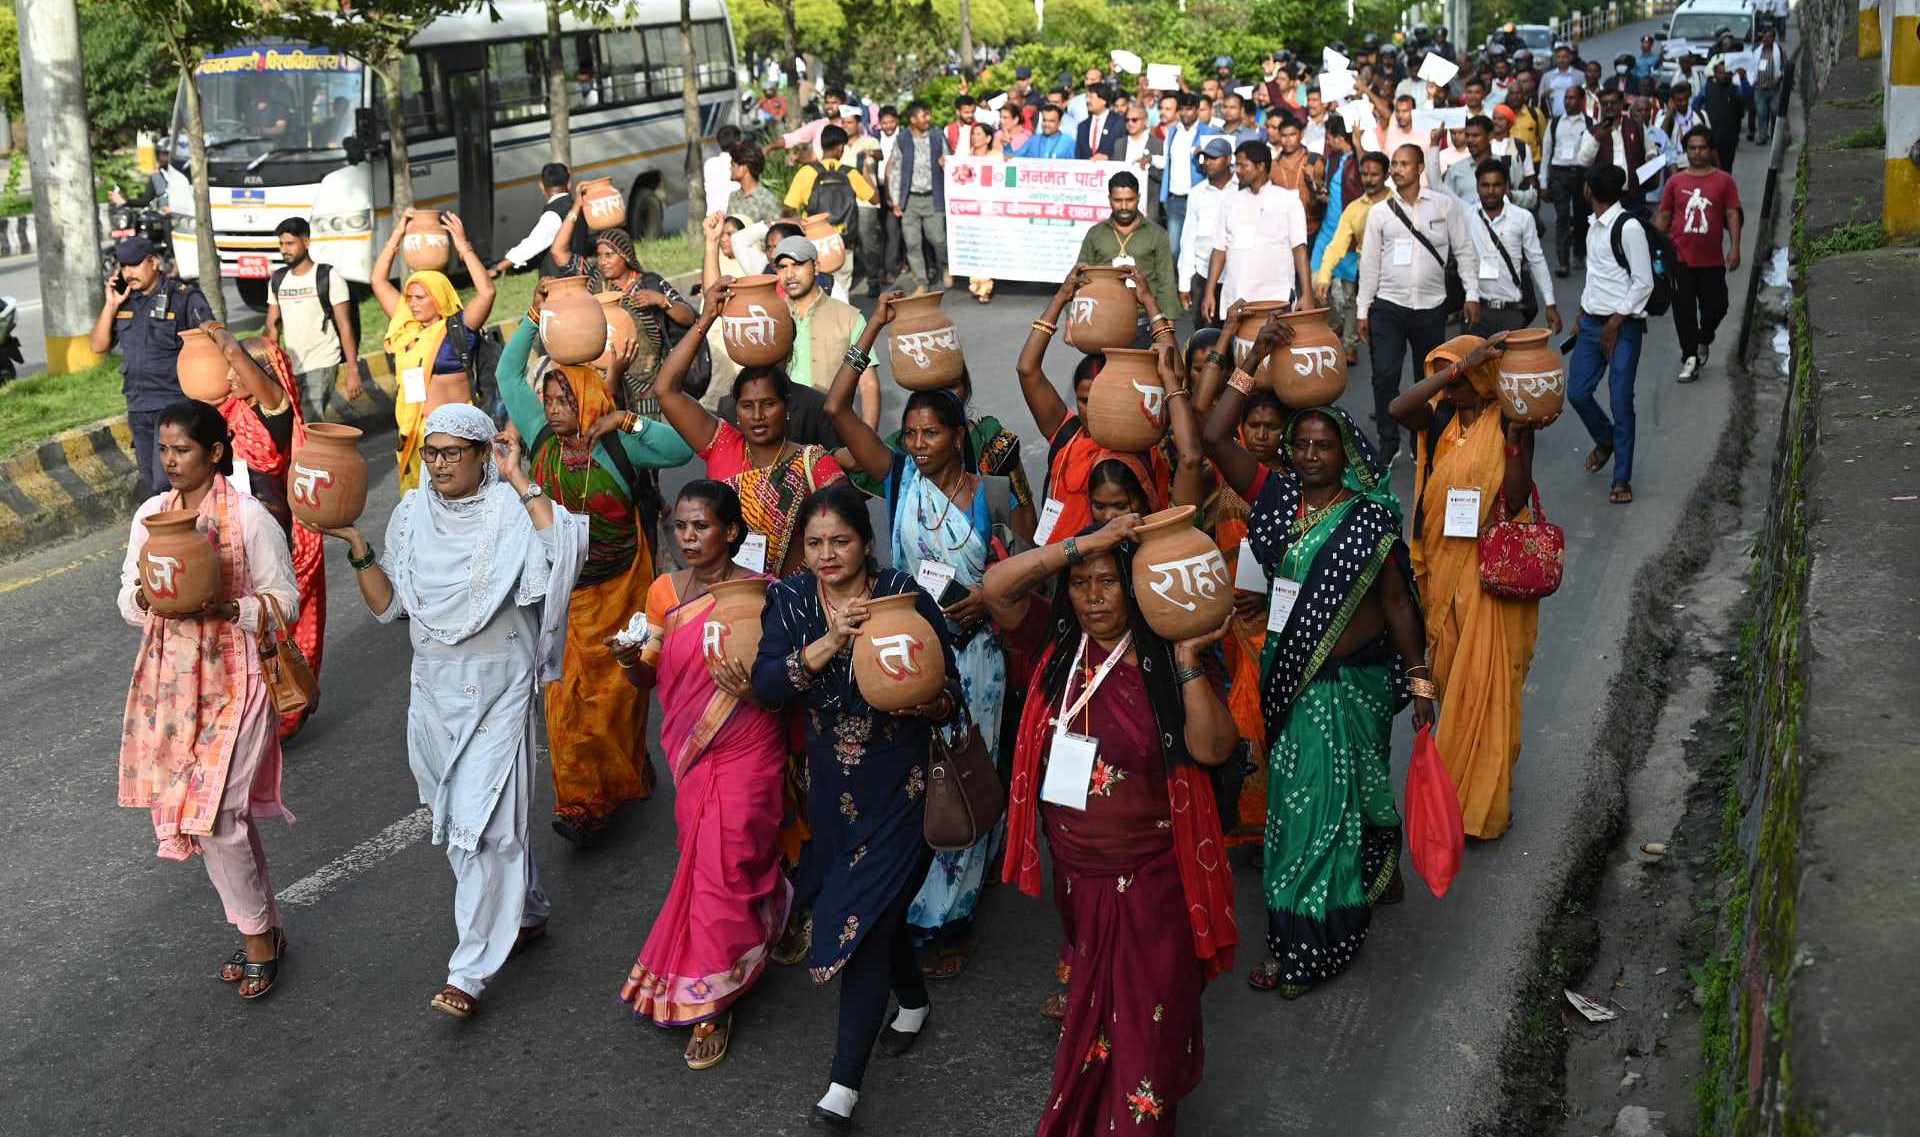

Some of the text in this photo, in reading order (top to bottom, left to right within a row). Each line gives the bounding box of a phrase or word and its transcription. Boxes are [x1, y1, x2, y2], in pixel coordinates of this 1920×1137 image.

[1019, 168, 1105, 188] जनमत पार्टी
[1148, 549, 1230, 612] राहत
[872, 634, 918, 675] त
